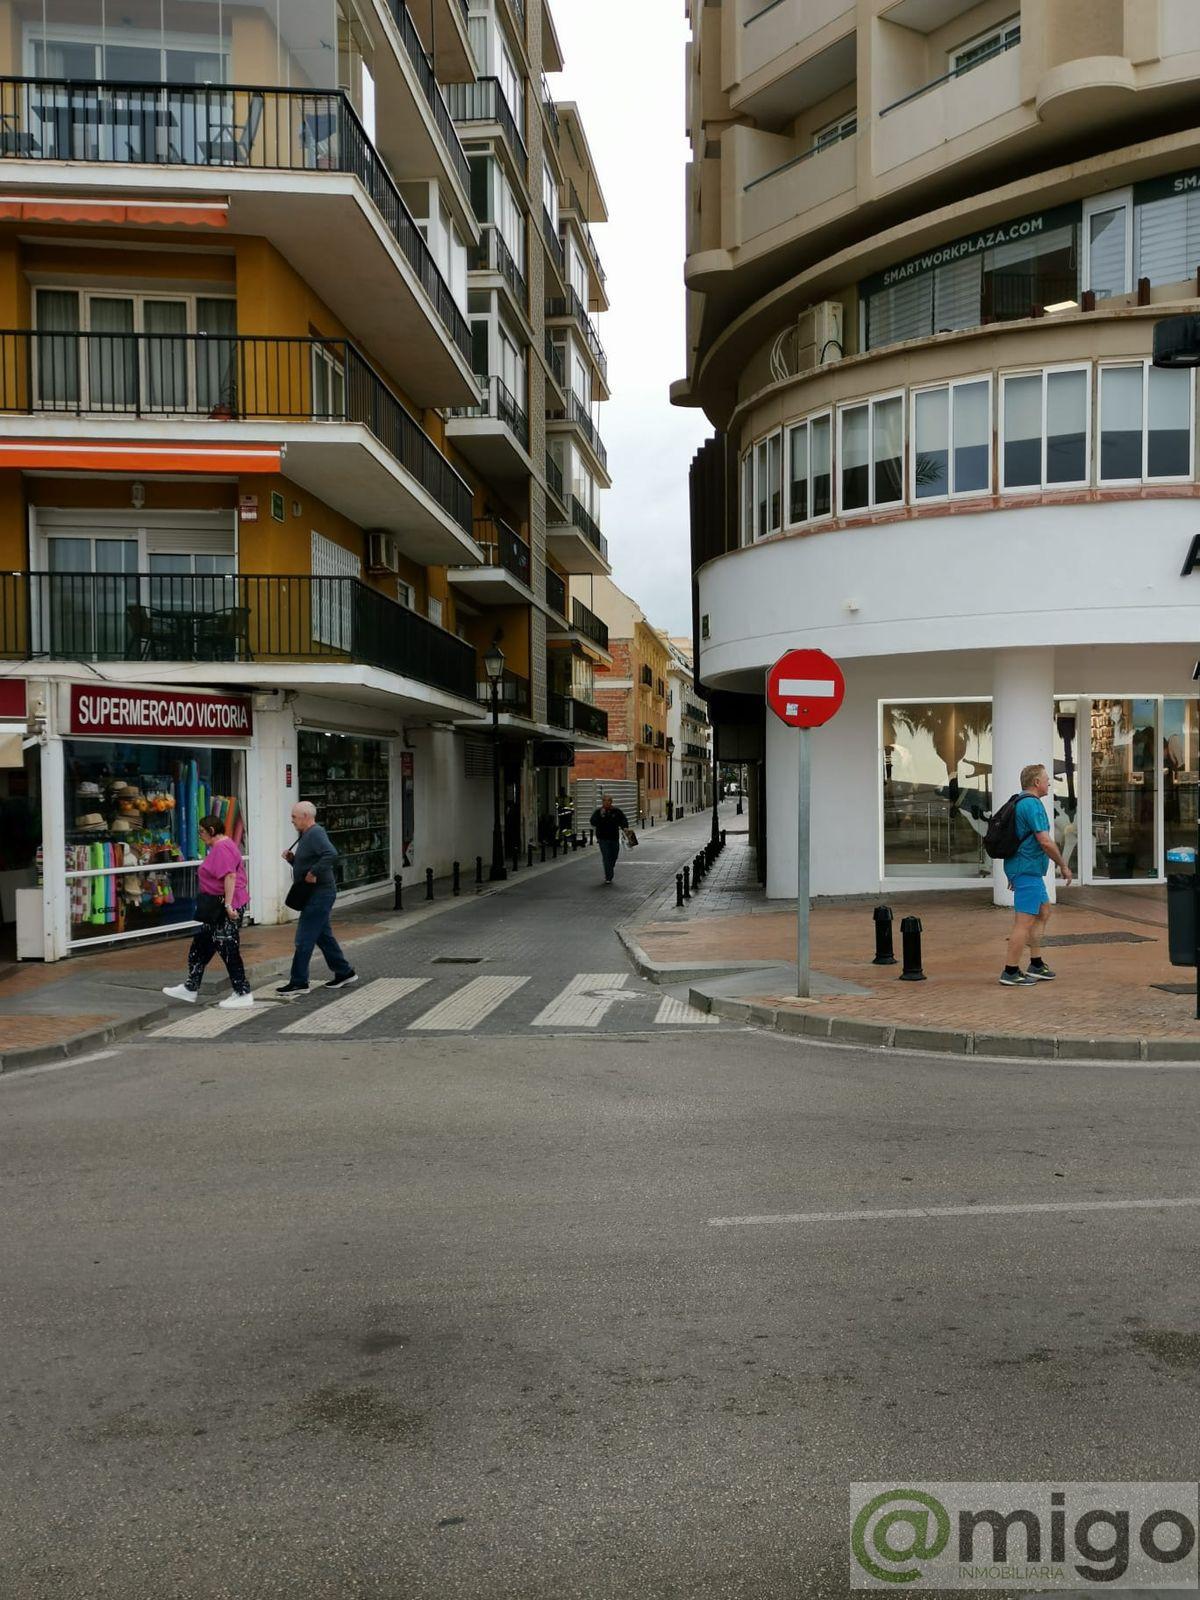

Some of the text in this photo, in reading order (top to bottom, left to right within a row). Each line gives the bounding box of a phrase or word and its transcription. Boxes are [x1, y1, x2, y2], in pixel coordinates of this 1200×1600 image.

[1174, 175, 1200, 191] SM
[883, 217, 1043, 285] SMARTWORKPLAZA.COM
[78, 695, 248, 728] SUPERMERCADO VICTORIA
